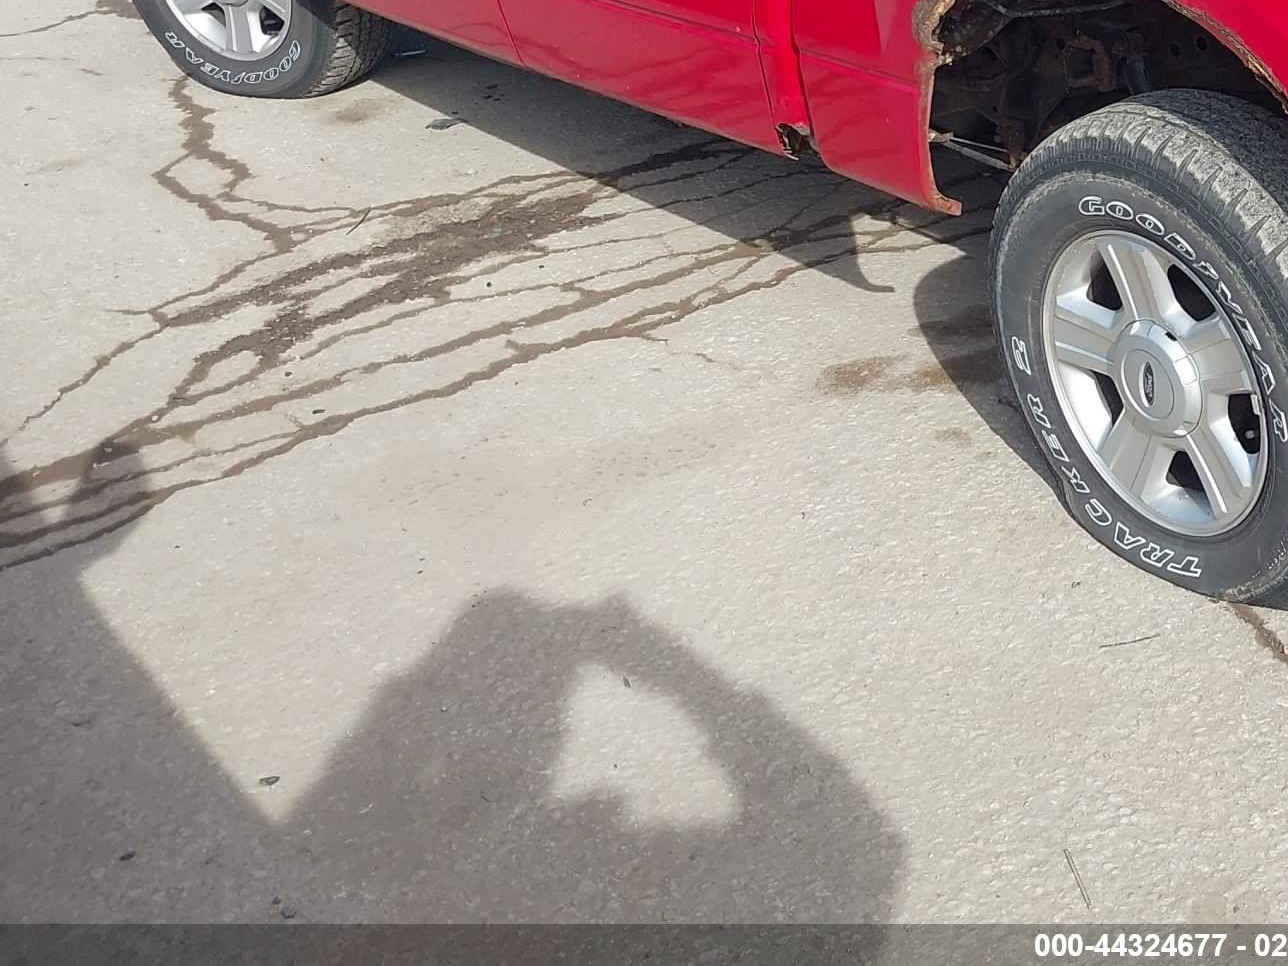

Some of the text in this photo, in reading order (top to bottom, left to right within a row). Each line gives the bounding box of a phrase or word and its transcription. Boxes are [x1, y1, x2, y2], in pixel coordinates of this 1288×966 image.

[165, 30, 301, 84] GOODYEAR
[1078, 196, 1288, 443] GOODYEAR
[1011, 336, 1202, 578] TRACKER 2
